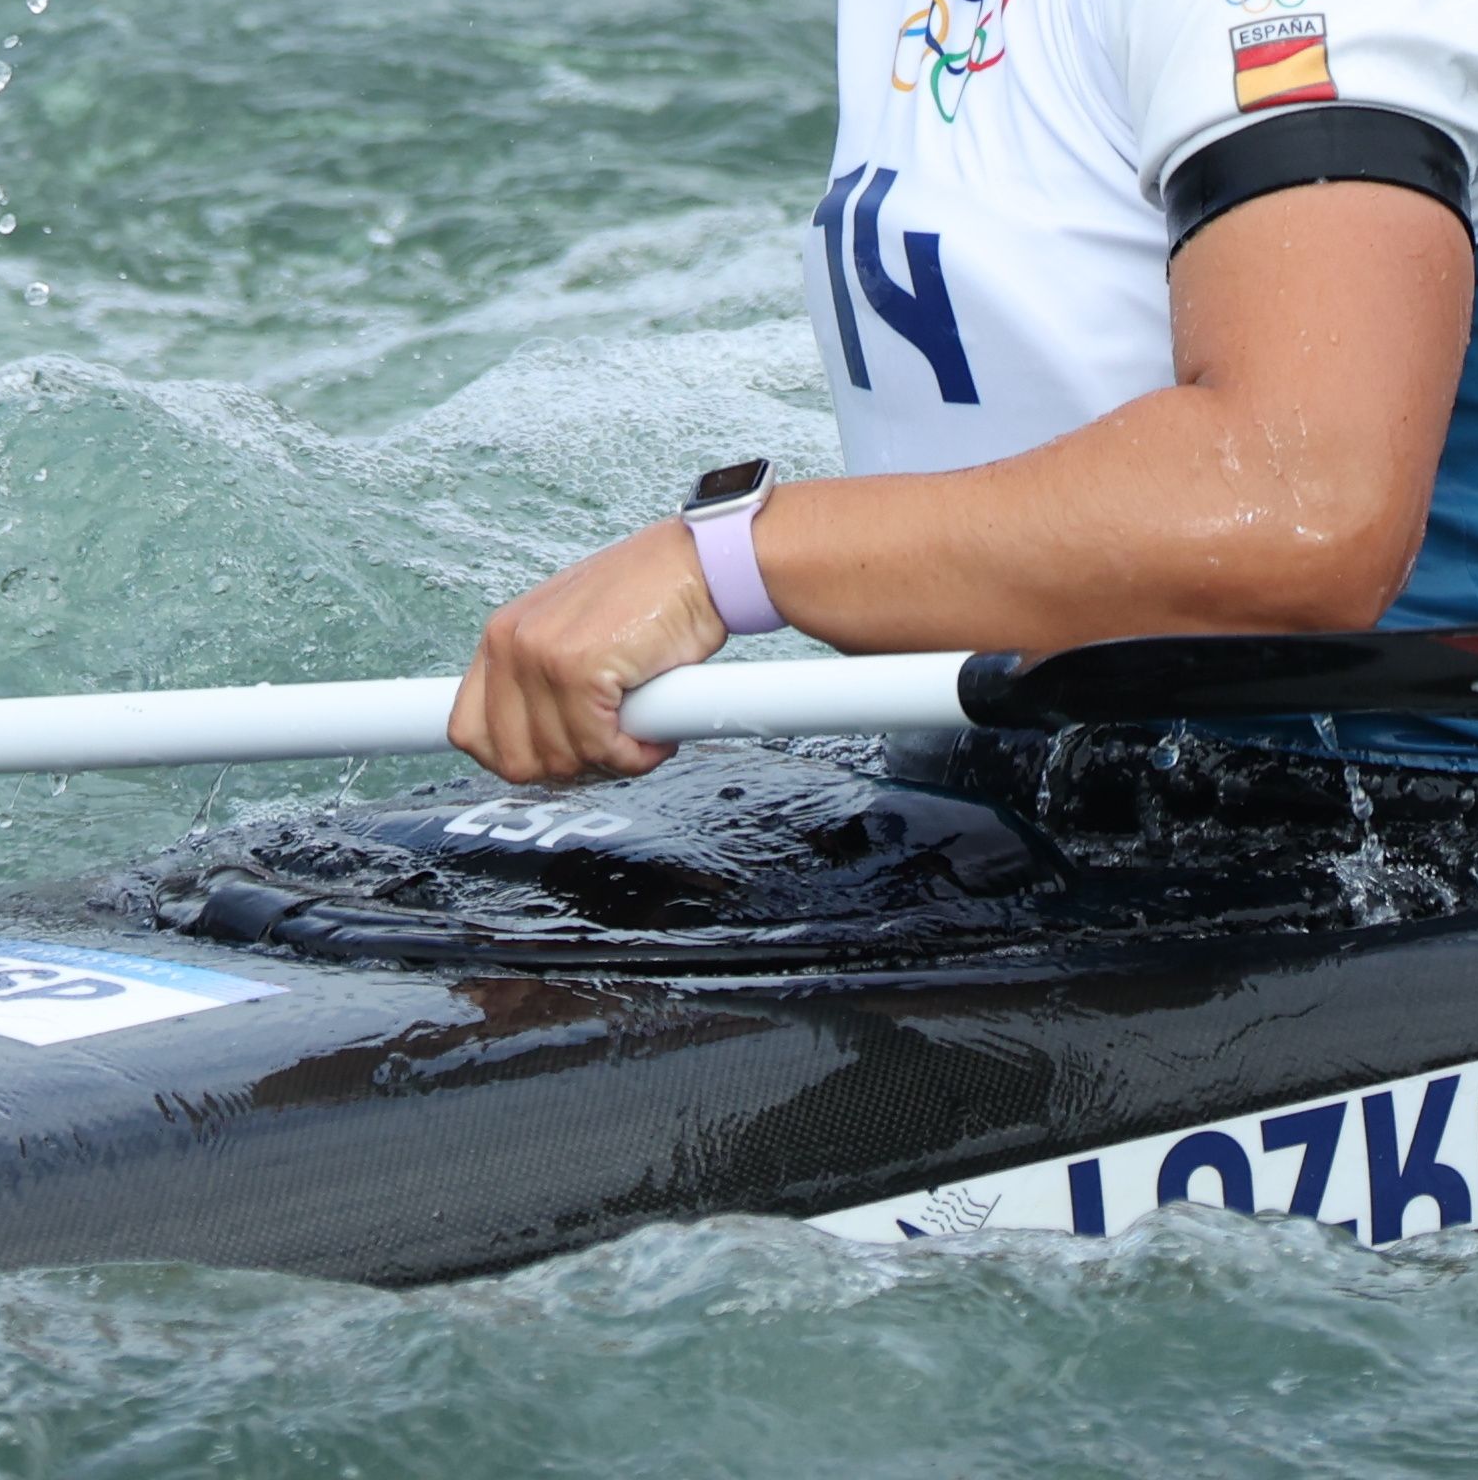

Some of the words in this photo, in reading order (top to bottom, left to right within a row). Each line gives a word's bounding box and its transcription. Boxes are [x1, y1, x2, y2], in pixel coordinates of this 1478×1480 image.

[1239, 19, 1317, 46] ESPAÑA
[812, 160, 981, 405] 14
[443, 797, 633, 849] ESP
